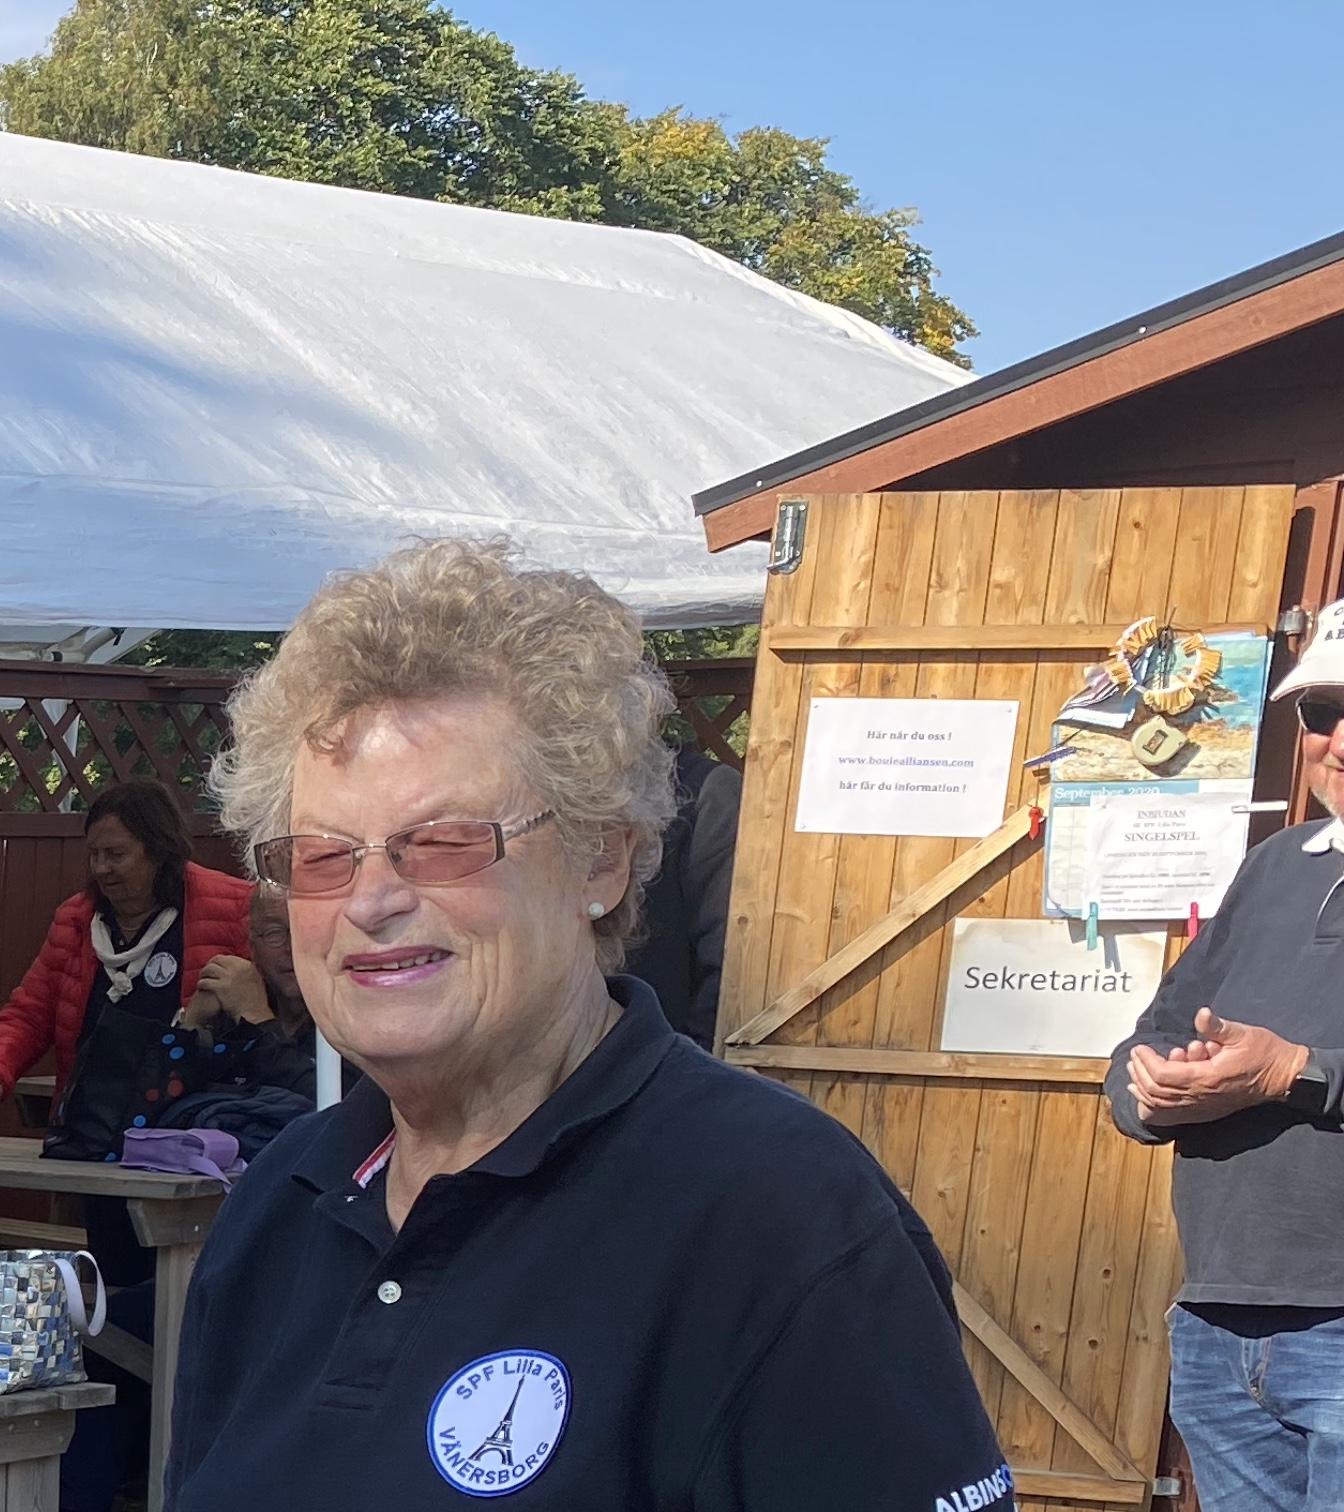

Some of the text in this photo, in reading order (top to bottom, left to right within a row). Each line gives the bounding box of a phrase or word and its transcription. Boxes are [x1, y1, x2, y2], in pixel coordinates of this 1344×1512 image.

[867, 730, 887, 740] Här
[911, 731, 925, 741] du
[928, 733, 945, 741] oss
[878, 781, 892, 791] du
[895, 782, 960, 793] information
[1124, 831, 1200, 842] SINGELSPEL
[964, 965, 1133, 993] Sekretariat
[456, 1359, 567, 1411] SPF Lilla Paris
[439, 1426, 549, 1485] VÄNERSBORG
